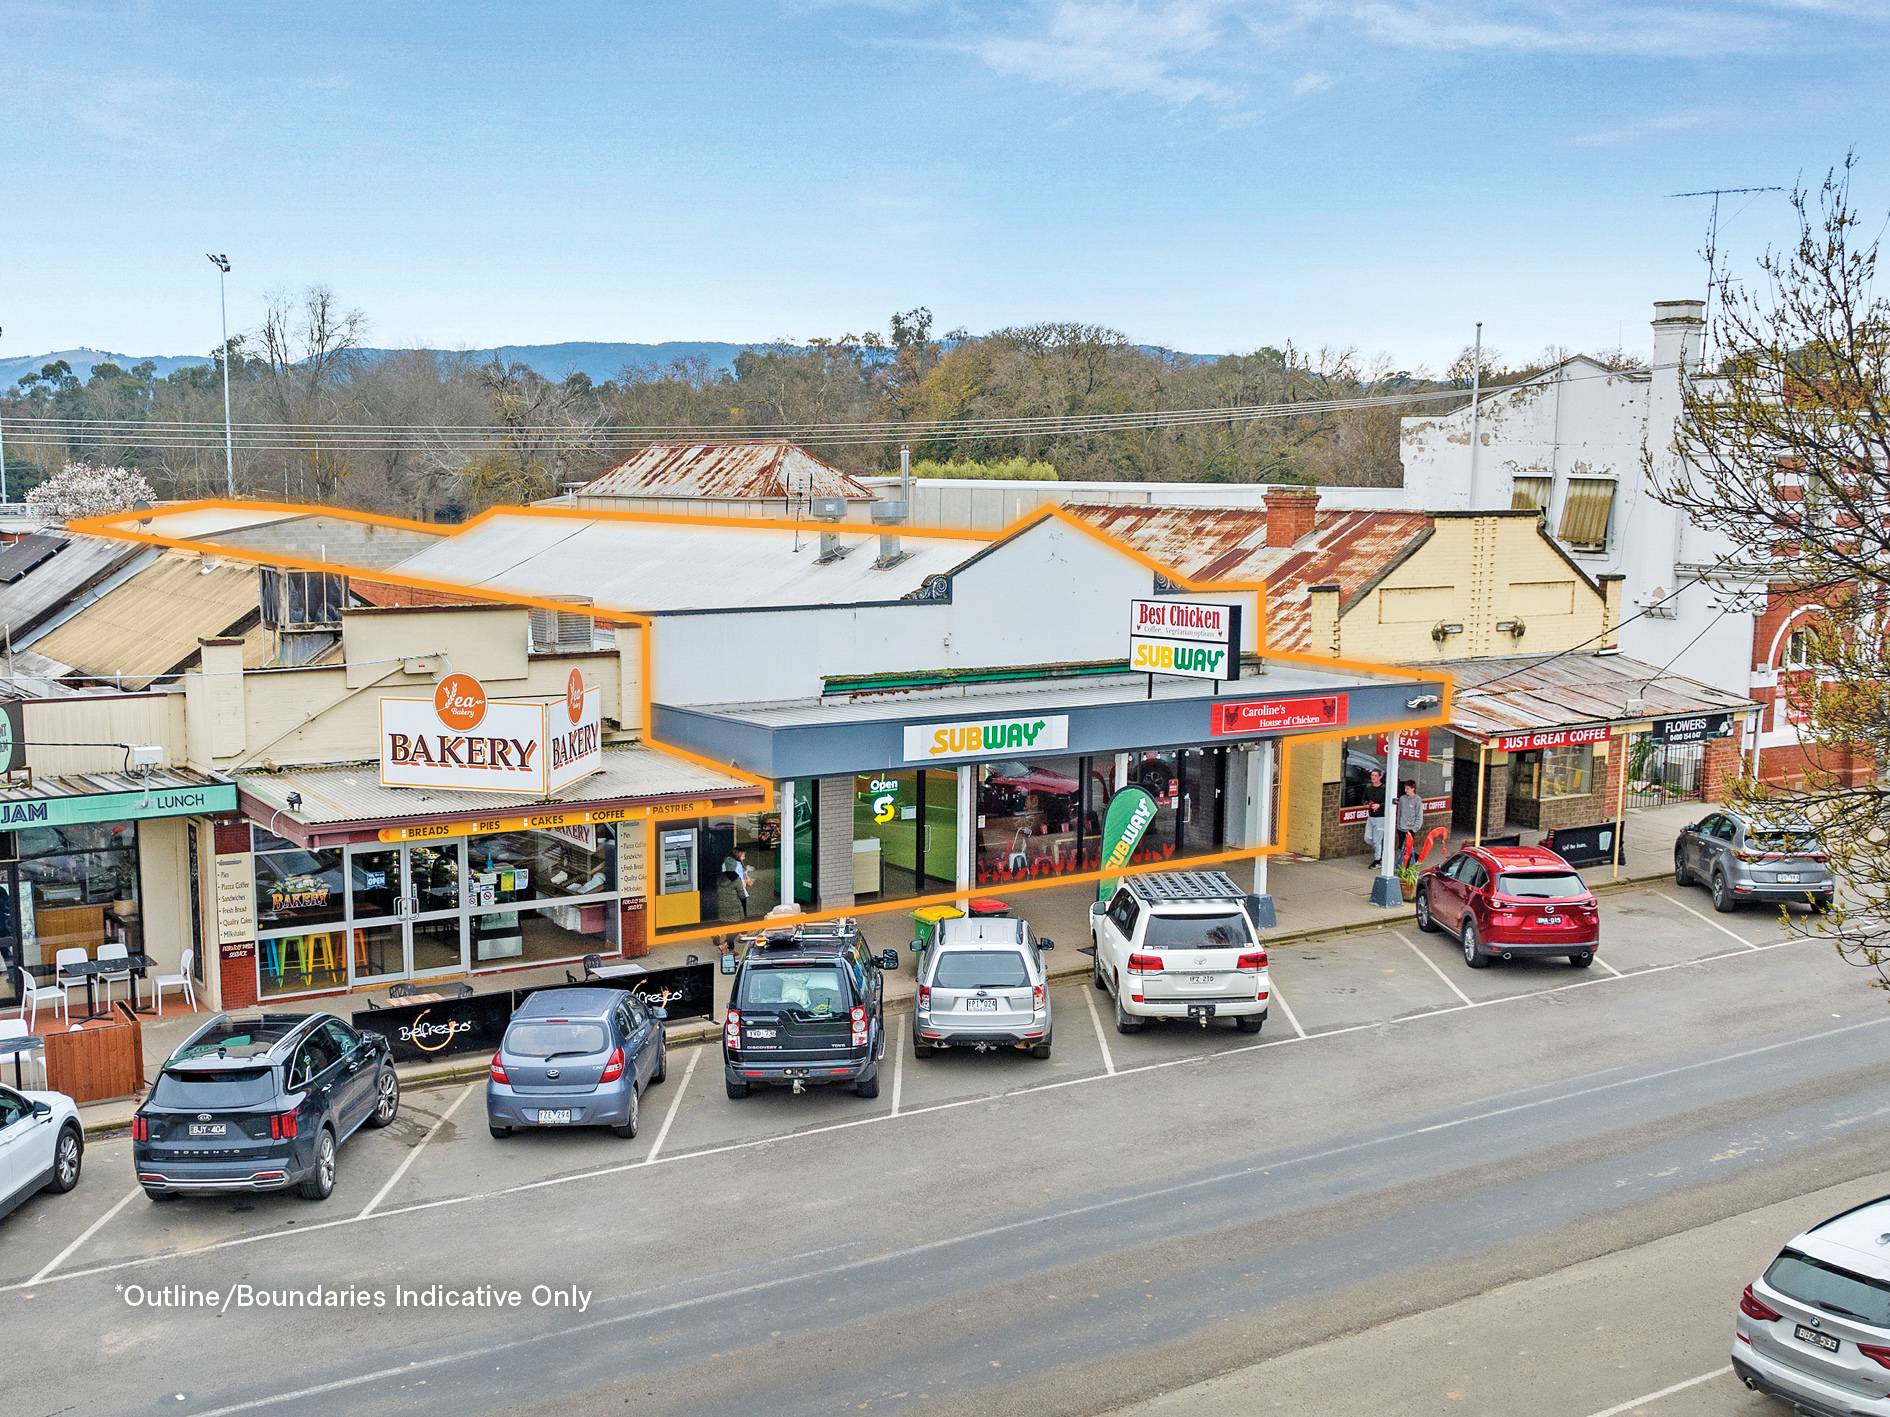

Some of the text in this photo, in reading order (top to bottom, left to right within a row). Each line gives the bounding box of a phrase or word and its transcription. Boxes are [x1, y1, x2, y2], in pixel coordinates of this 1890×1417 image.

[1139, 603, 1221, 630] Best Chicken
[1165, 628, 1194, 636] Vegetarian
[1134, 644, 1225, 673] SUBWAY
[450, 707, 475, 719] Bakery
[1242, 704, 1286, 718] Caroline's
[1260, 715, 1320, 728] House of Chicken
[1665, 718, 1707, 734] FLOWERS
[552, 720, 599, 770] BAKERY
[929, 719, 1046, 756] SUBWAY
[1503, 727, 1607, 750] JUST GREAT COFFEE
[388, 732, 538, 773] BAKERY
[870, 780, 898, 792] Open
[157, 793, 205, 809] LUNCH
[1428, 800, 1447, 811] COFFEE
[1, 802, 48, 824] JAM
[408, 803, 694, 837] BREADS PIES CAKES COFFEE PASTRIES
[1343, 811, 1357, 821] JUST
[368, 877, 386, 886] OPEN
[271, 889, 329, 912] BAKERY
[398, 1020, 472, 1041] Belfresco
